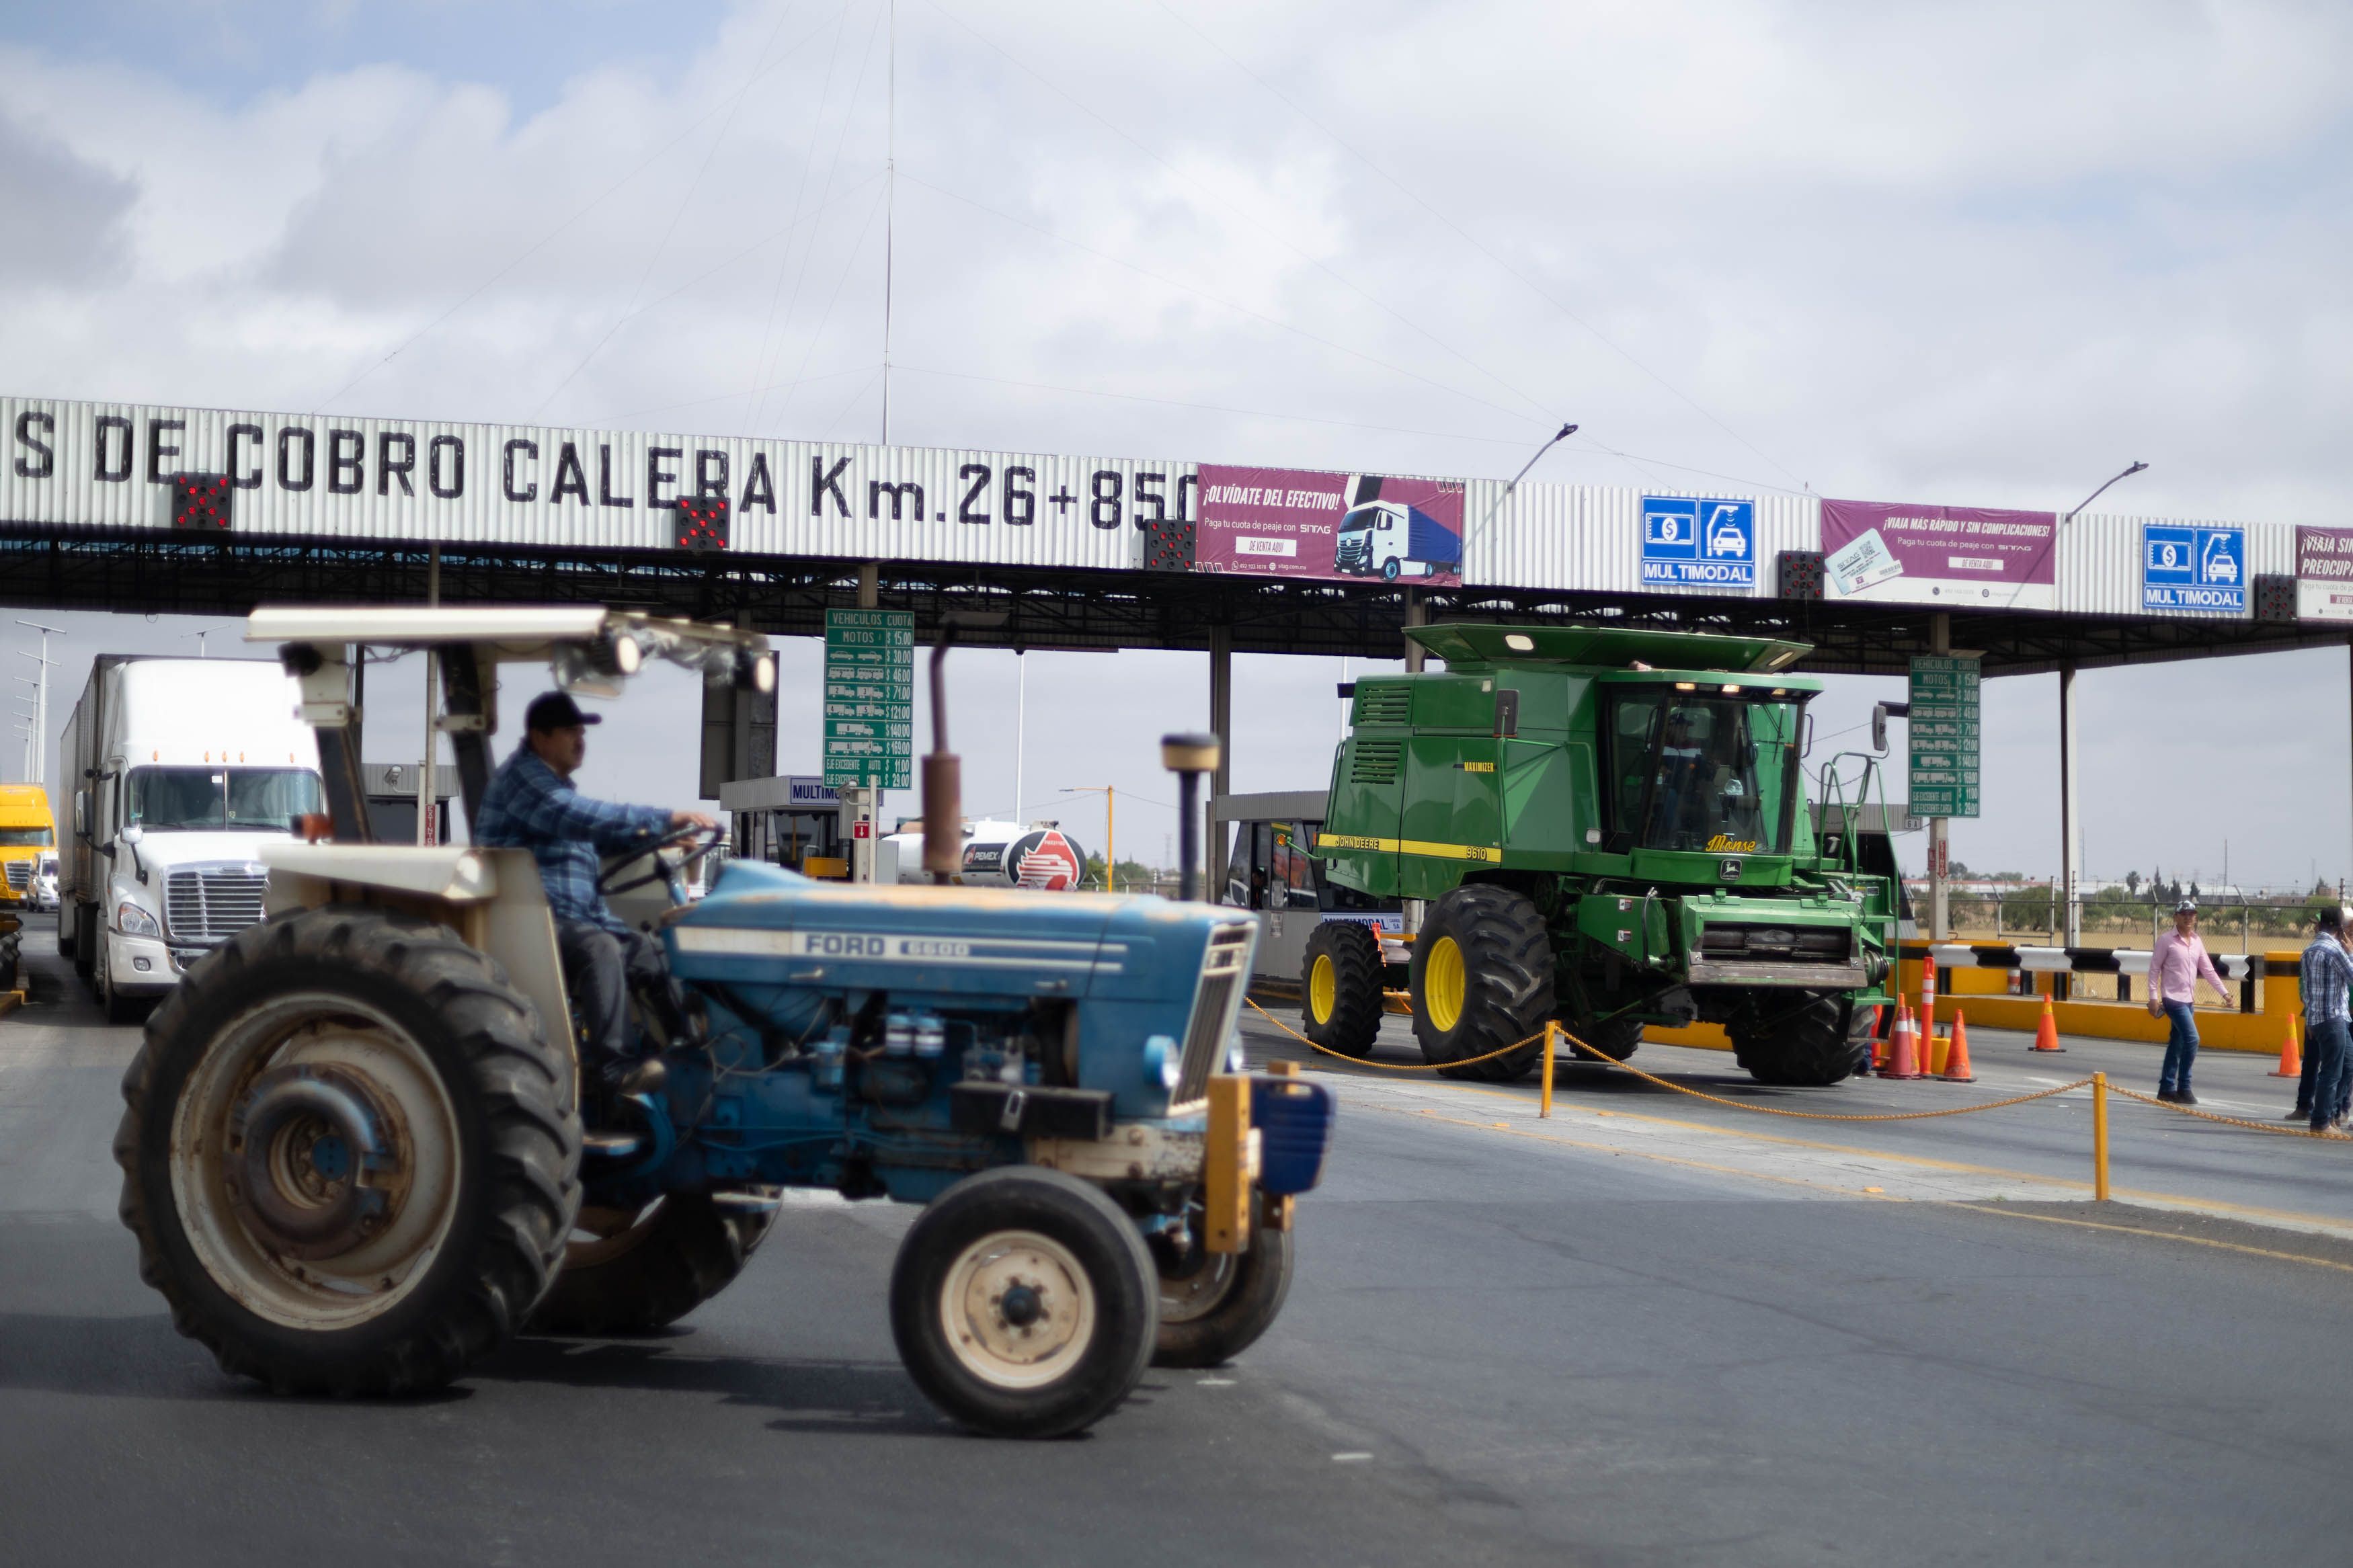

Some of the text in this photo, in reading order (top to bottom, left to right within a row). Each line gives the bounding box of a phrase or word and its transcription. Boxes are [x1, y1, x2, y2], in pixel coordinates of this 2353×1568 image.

[94, 415, 186, 485] DE
[227, 422, 465, 499] COBRO
[503, 438, 777, 515] CALERA
[1203, 483, 1341, 510] ¡OLVÍDATE DEL EFECTIVO!
[1204, 518, 1222, 530] Paga
[1224, 520, 1231, 528] tu
[1232, 521, 1251, 530] cuota
[1252, 520, 1262, 530] de
[1263, 522, 1282, 534] peaje
[1283, 524, 1296, 532] con
[1883, 516, 2050, 538] ¡VIAJA MÁS RÁPIDO Y SIN COMPLICACIONES!
[1249, 540, 1257, 552] DE
[1257, 540, 1272, 552] VENTA
[1897, 537, 1916, 547] Paga
[1917, 538, 1925, 546] tu
[1948, 538, 1958, 548] de
[1959, 541, 1981, 551] peaje
[2301, 536, 2353, 554] ¡VIAJA SIN
[1644, 563, 1752, 582] MULTIMODAL
[2146, 589, 2242, 607] MULTIMODAL
[832, 612, 912, 627] VEHICULOS CUOTA
[843, 631, 912, 646] MOTOS $ 15.00
[886, 650, 911, 663] $ 30.00
[1915, 659, 1979, 671] VEHICULOS CUOTA
[886, 669, 890, 682] $
[893, 669, 910, 683] 46.00
[1923, 674, 1948, 684] MOTOS
[886, 686, 890, 699] $
[893, 686, 910, 700] 71.00
[890, 705, 910, 720] 121.00
[890, 723, 910, 738] 140.00
[891, 741, 910, 755] 169.00
[826, 759, 910, 773] EJE EXCEDENTE AUTO $ 11.00
[1464, 761, 1494, 772] MAXIMIZER
[826, 774, 835, 785] EJE
[866, 774, 882, 786] CGA
[885, 774, 889, 786] $
[892, 774, 910, 787] 29.00
[1335, 835, 1380, 850] JOHN DEERE
[1704, 834, 1756, 853] Monse
[974, 852, 999, 860] PEMEX
[1466, 846, 1488, 860] 9610
[806, 934, 971, 957] FORD 6600
